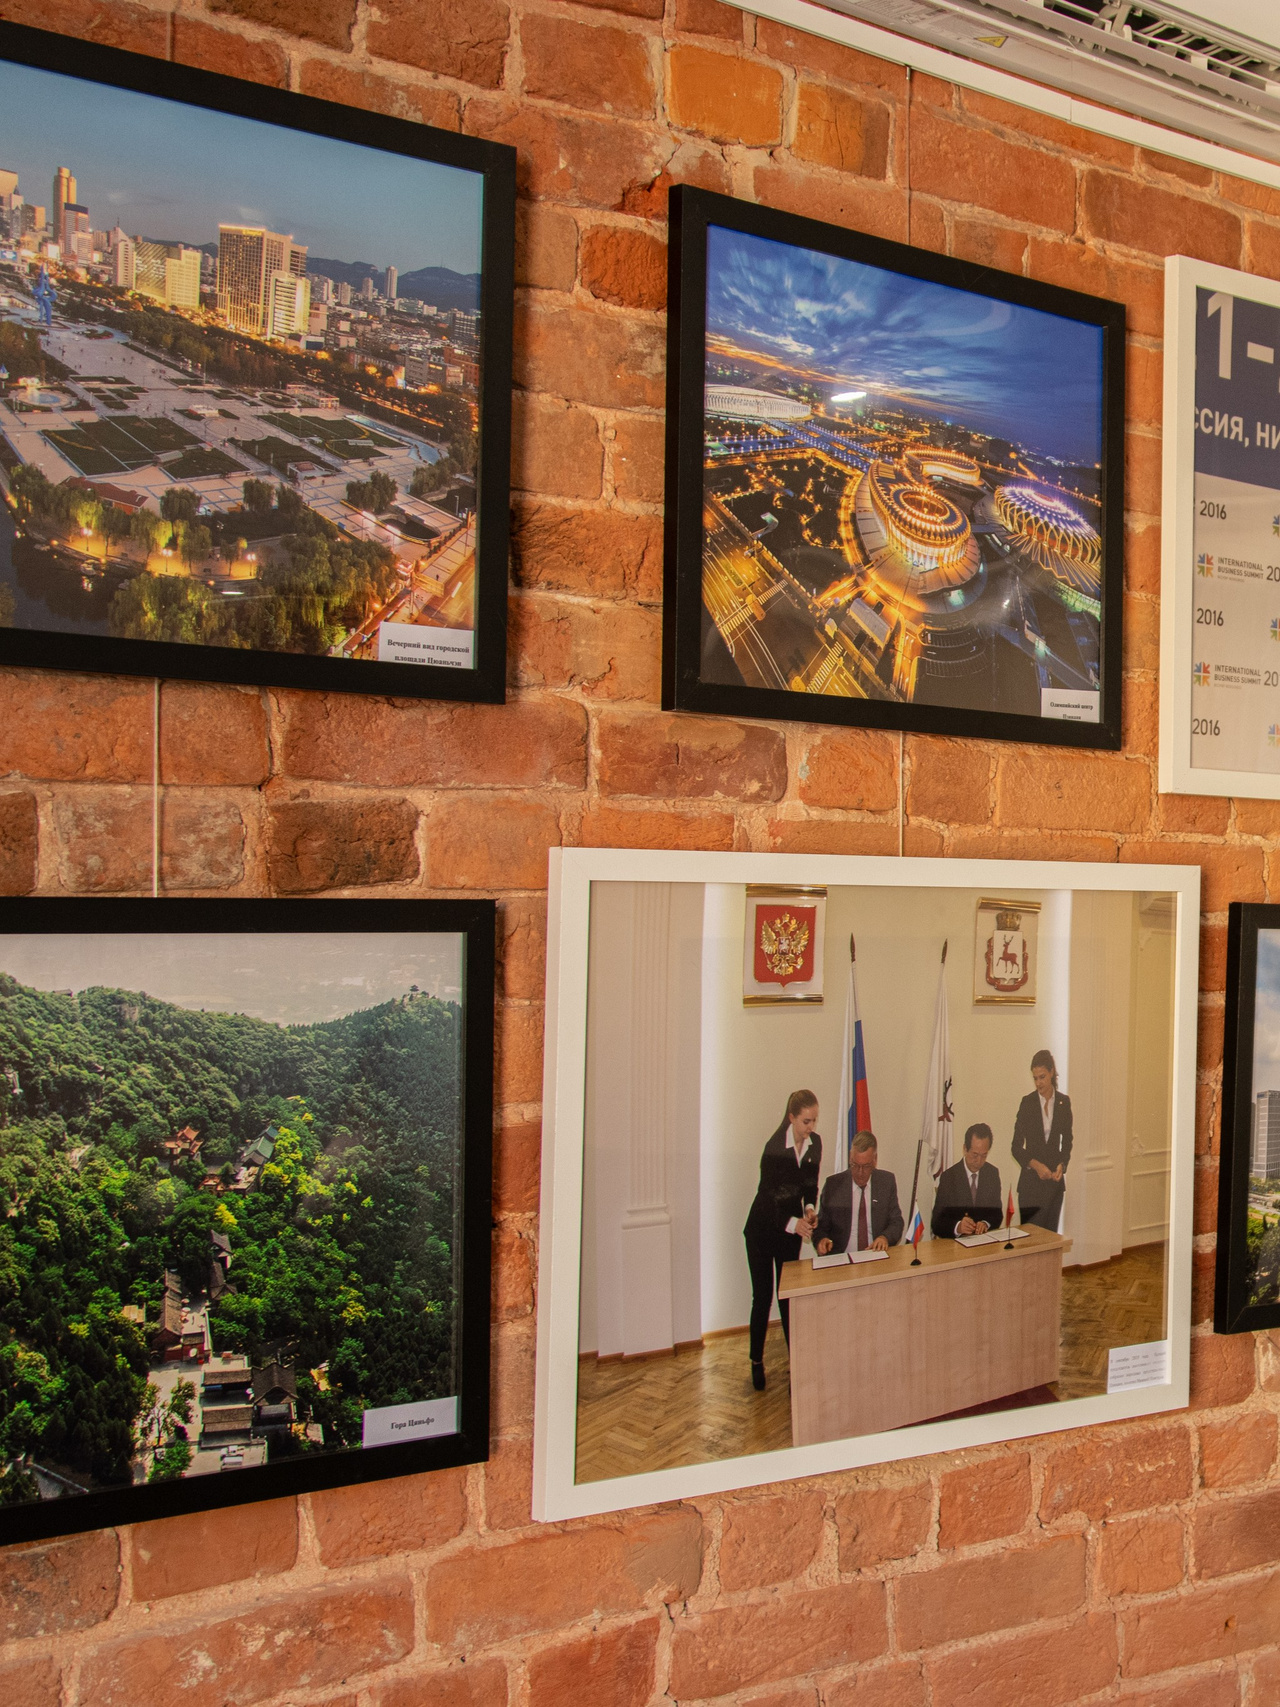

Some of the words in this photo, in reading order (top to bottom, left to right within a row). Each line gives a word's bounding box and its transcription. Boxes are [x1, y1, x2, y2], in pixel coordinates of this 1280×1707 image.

[1199, 499, 1227, 520] 2016
[1217, 556, 1264, 572] INTERNATIONAL
[1217, 565, 1243, 577] BUSINESS
[1243, 569, 1264, 579] SUMMIT
[1196, 607, 1224, 627] 2016
[387, 638, 421, 649] Вечерний
[422, 643, 435, 651] вид
[436, 644, 470, 654] городской
[394, 655, 426, 664] площади
[1214, 664, 1261, 677] INTERNATIONAL
[1214, 673, 1241, 683] BUSINESS
[1241, 676, 1262, 686] SUMMIT
[1191, 718, 1221, 737] 2016
[390, 1421, 407, 1430] Гора
